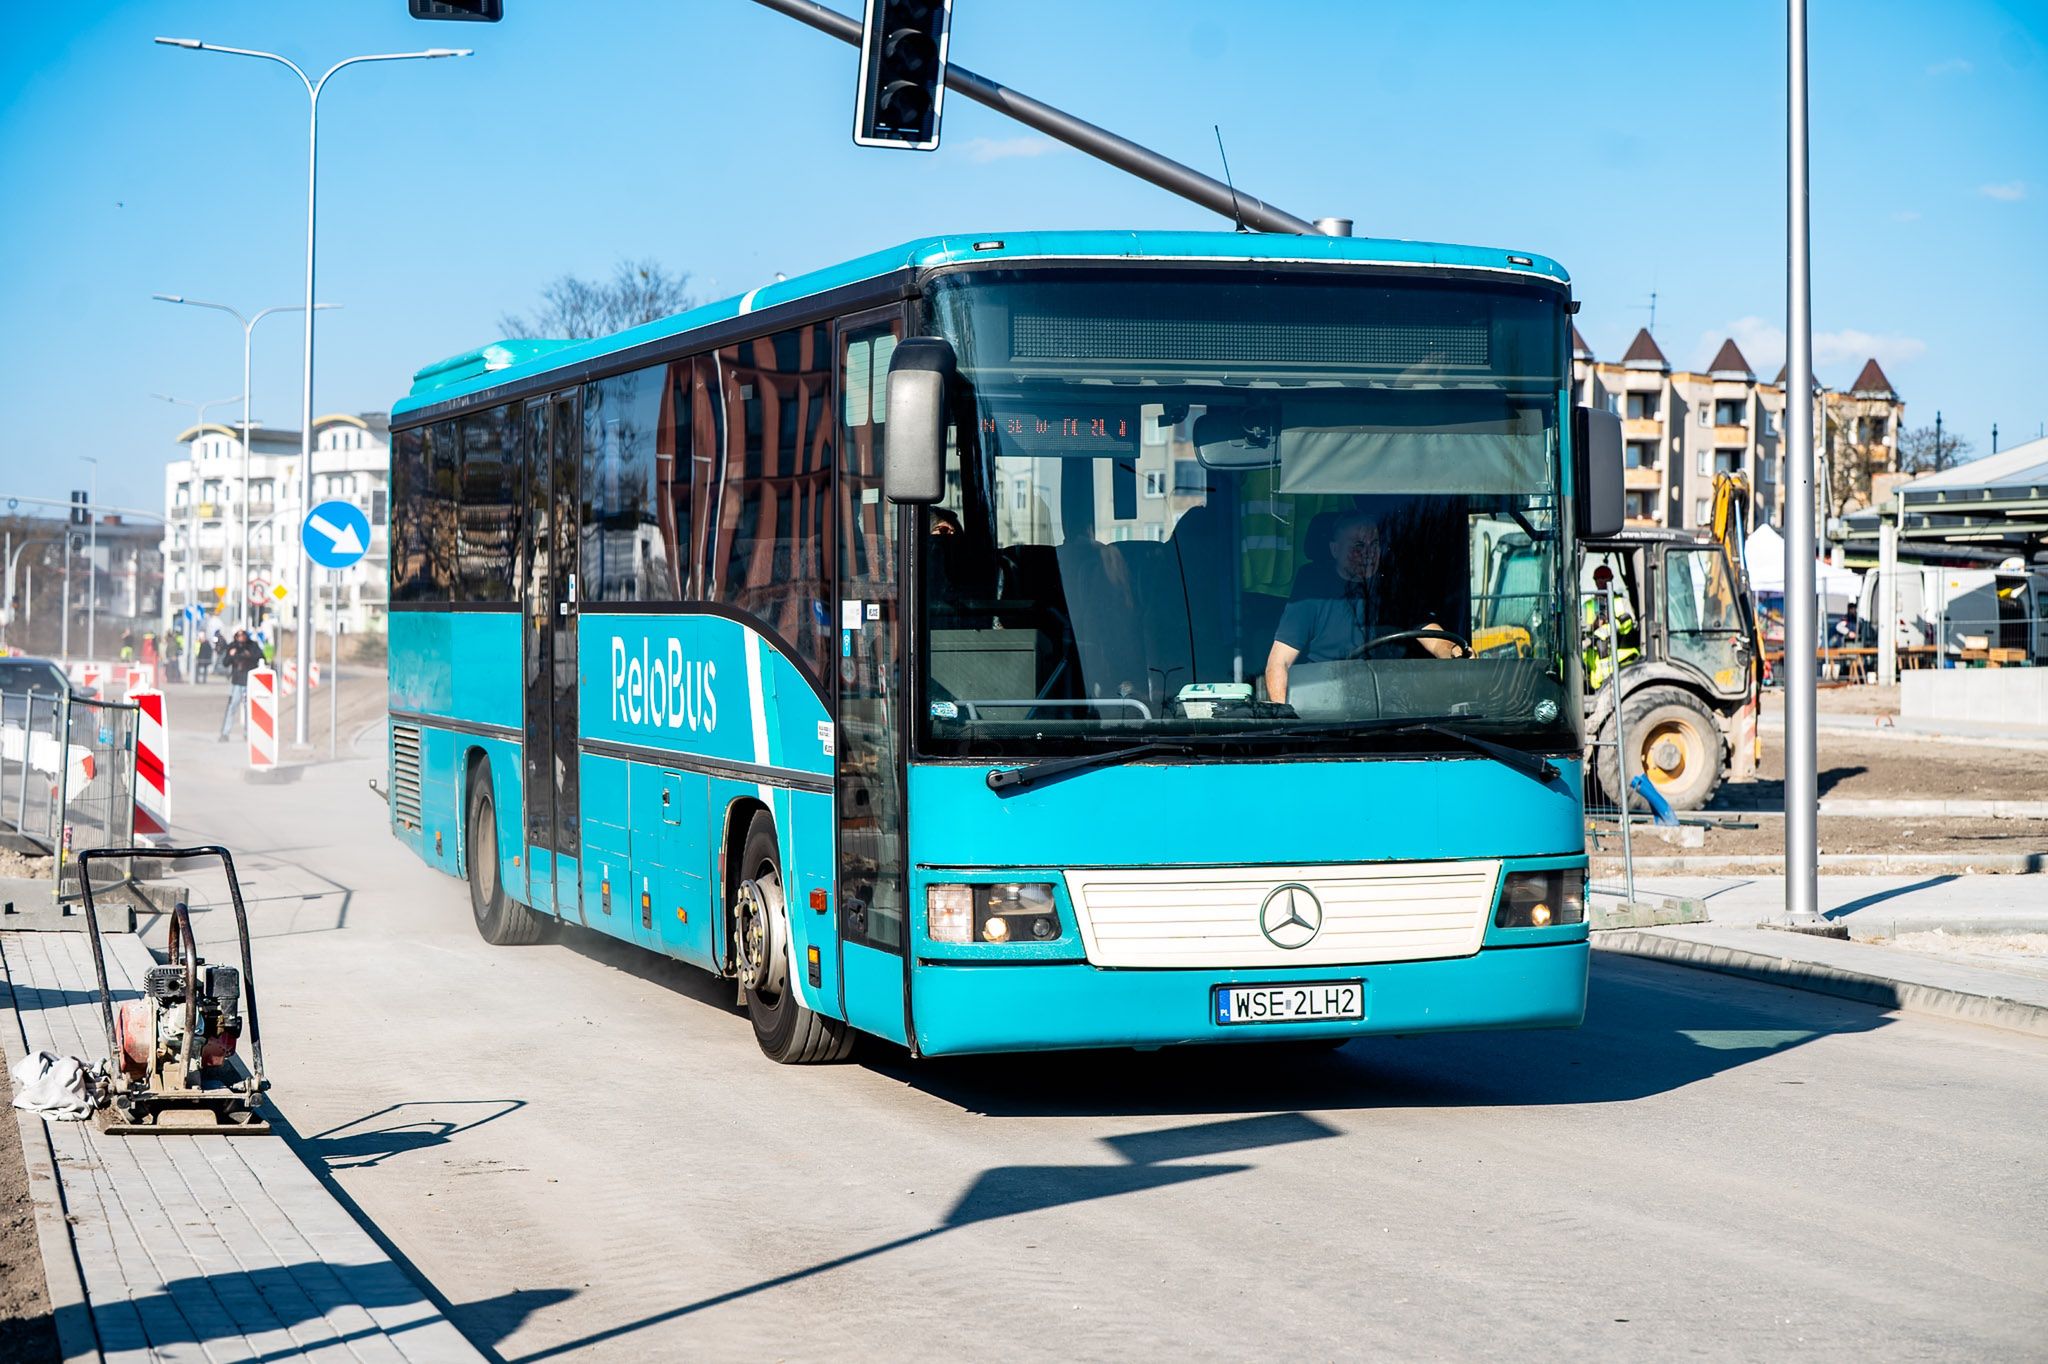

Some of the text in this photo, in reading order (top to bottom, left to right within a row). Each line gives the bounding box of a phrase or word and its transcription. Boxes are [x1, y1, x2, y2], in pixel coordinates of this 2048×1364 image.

[612, 636, 716, 733] ReloBus
[1236, 989, 1354, 1017] WSE 2LH2
